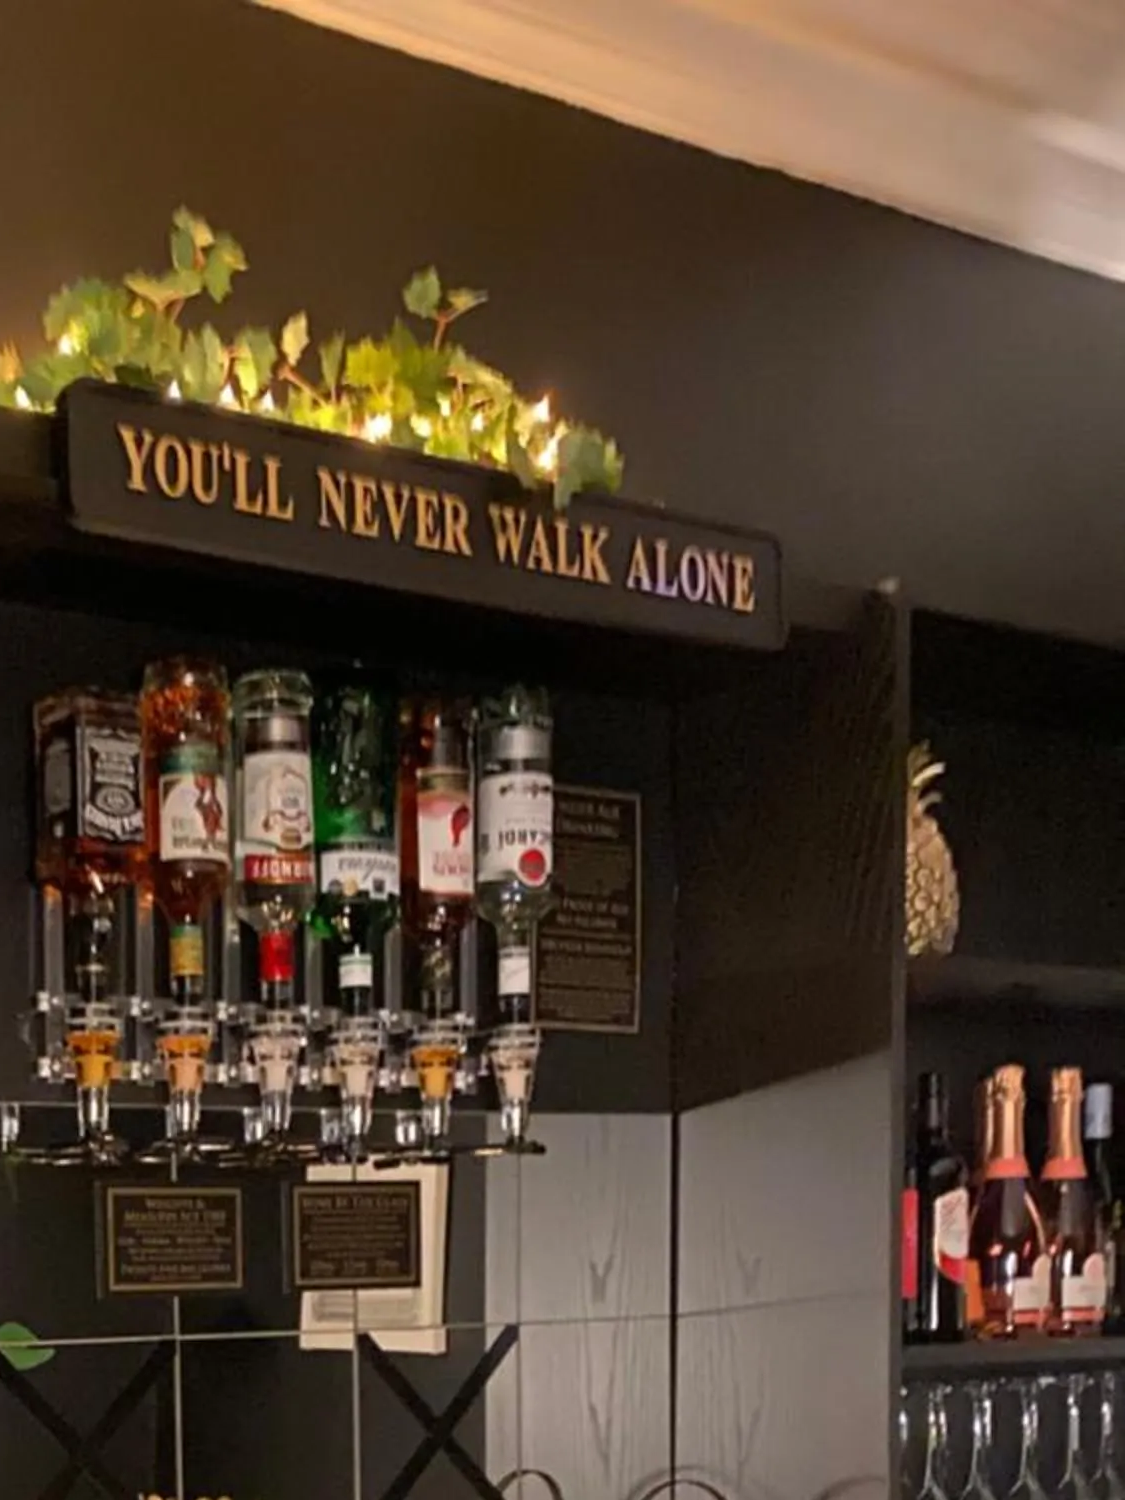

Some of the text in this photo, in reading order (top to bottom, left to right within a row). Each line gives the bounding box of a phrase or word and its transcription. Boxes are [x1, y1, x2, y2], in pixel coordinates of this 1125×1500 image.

[117, 423, 756, 613] YOU'LL NEVER WALK ALONE
